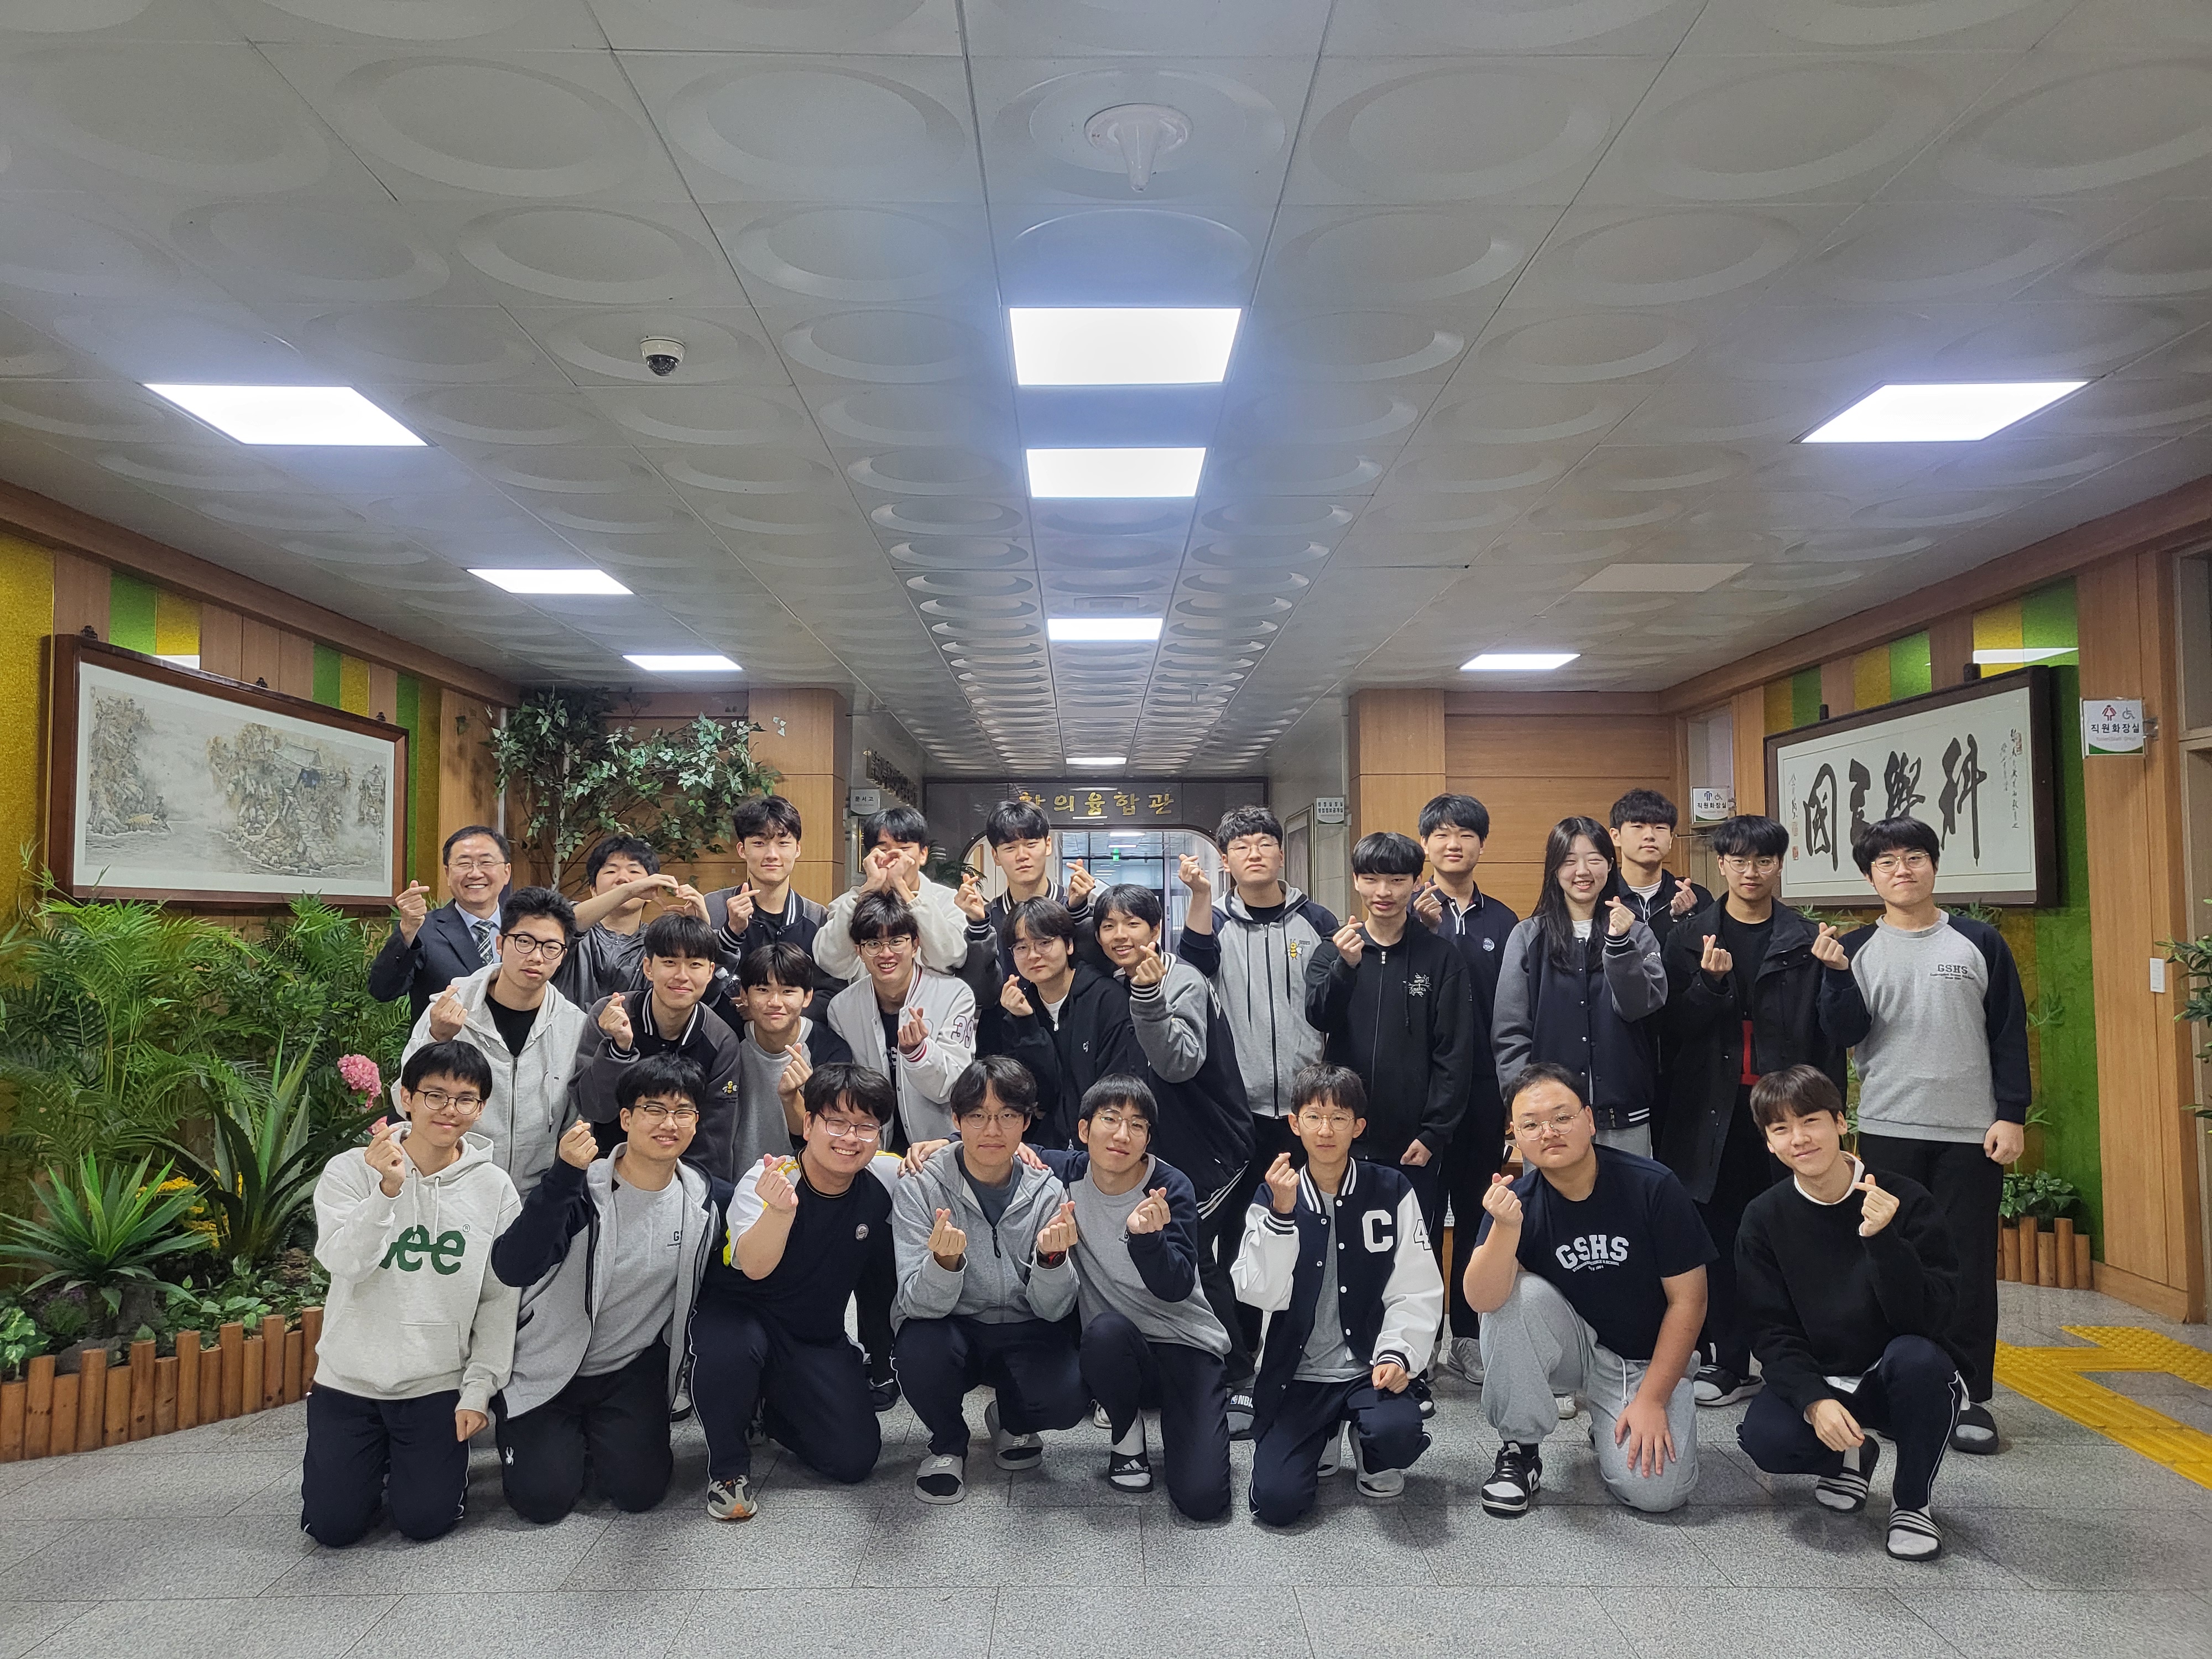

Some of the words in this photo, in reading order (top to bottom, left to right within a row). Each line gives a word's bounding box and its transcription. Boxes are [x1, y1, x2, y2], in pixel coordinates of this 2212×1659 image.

[2091, 723, 2140, 733] 직원화장실
[1937, 964, 1968, 974] GSHS
[1362, 1209, 1394, 1253] C
[1555, 1234, 1629, 1269] GSHS
